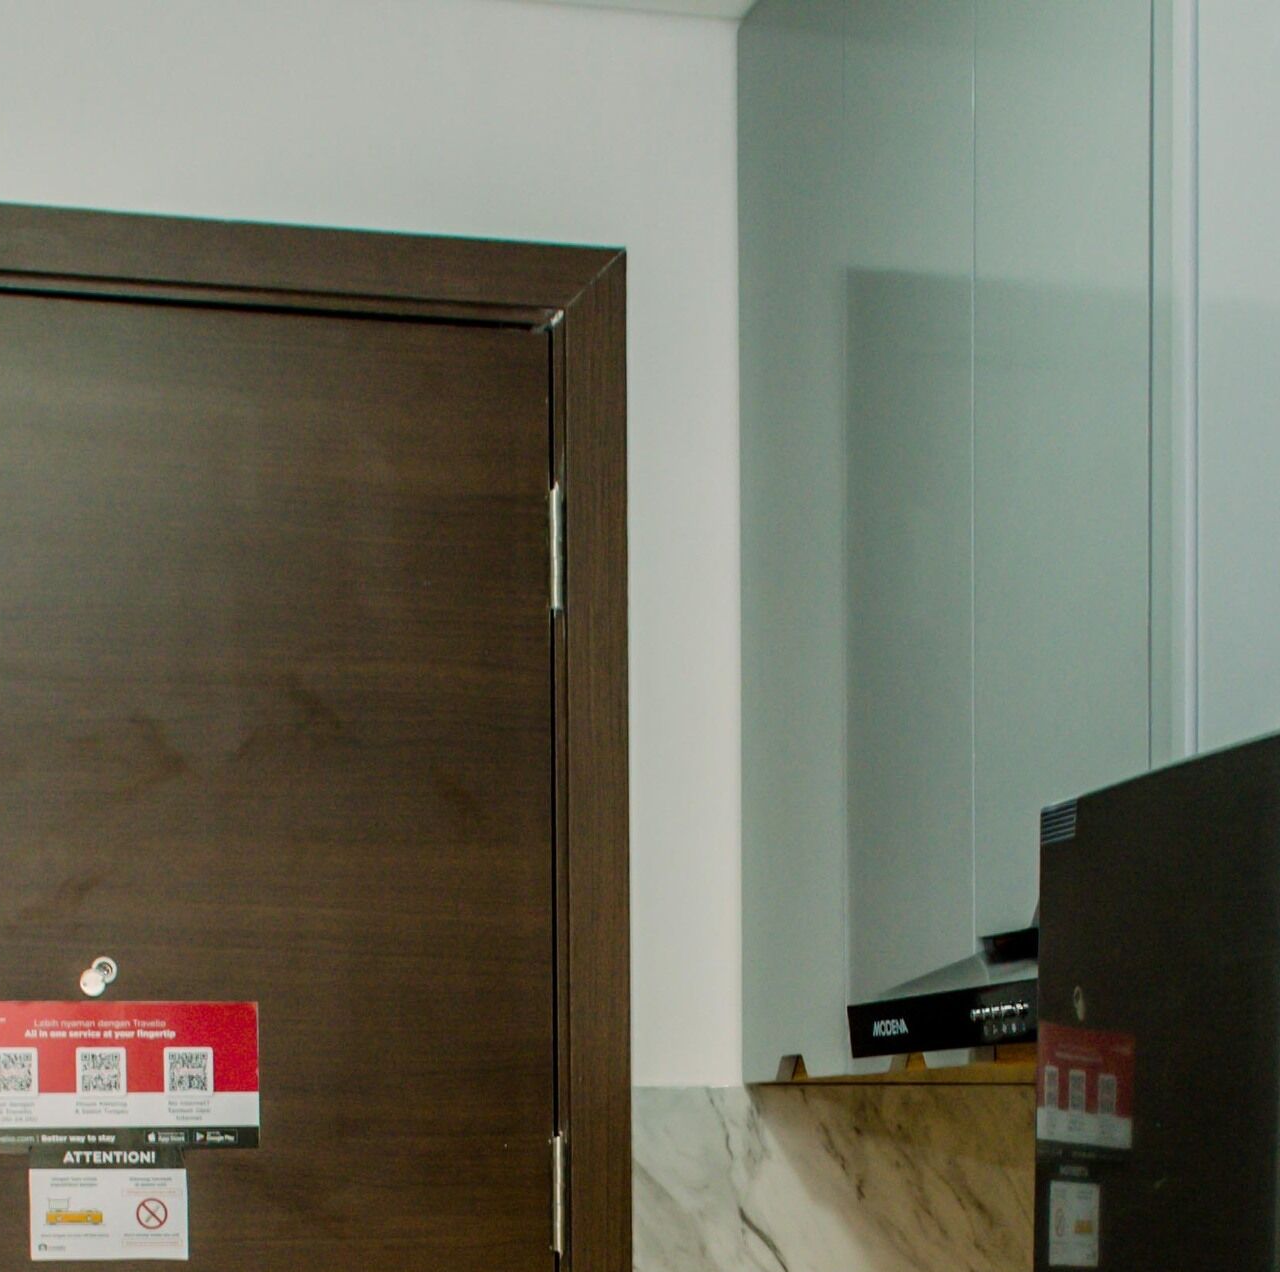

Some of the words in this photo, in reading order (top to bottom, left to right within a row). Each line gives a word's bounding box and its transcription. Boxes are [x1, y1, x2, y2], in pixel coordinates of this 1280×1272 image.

[132, 1019, 167, 1028] Travelio
[872, 1018, 909, 1037] MODENA
[24, 1029, 38, 1039] All
[39, 1029, 49, 1039] in
[49, 1030, 68, 1039] one
[68, 1029, 101, 1039] service
[102, 1030, 113, 1039] at
[113, 1030, 136, 1041] your
[137, 1029, 176, 1041] fingertip
[41, 1134, 67, 1144] Better
[68, 1135, 86, 1145] way
[87, 1134, 97, 1144] to
[98, 1134, 116, 1145] stay
[63, 1150, 156, 1164] ATTENTION!
